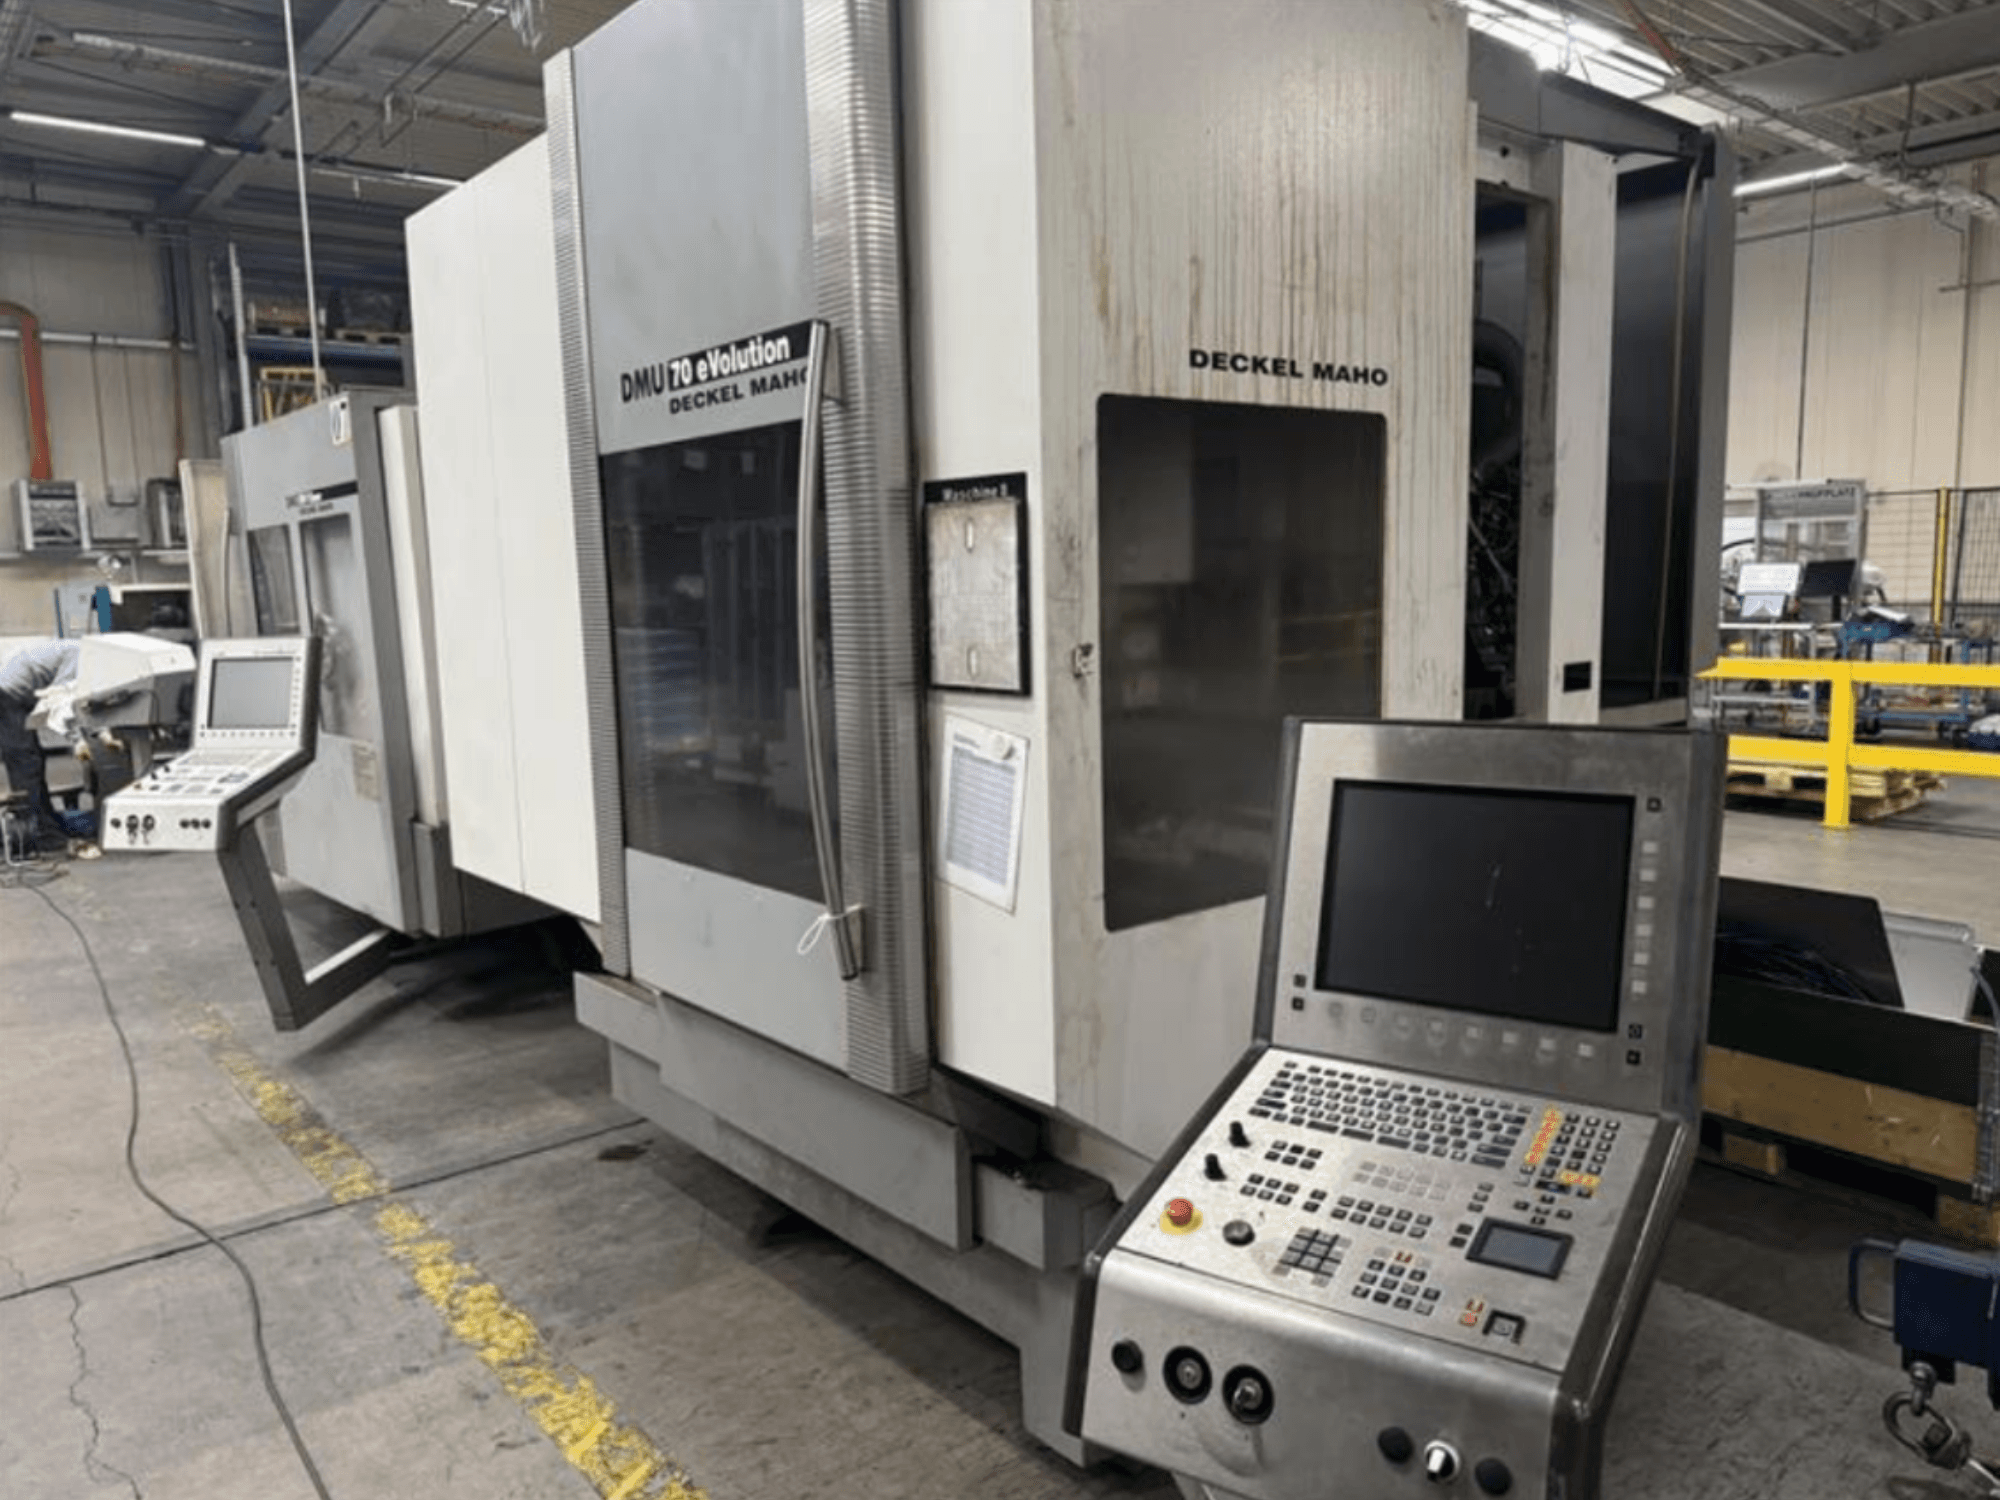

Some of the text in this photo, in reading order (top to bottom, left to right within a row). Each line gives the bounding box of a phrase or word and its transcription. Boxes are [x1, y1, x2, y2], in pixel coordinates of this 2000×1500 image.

[620, 333, 790, 403] DMU 70 eVolution
[1189, 349, 1389, 387] DECKEL MAHO
[669, 383, 745, 416] DECKEL
